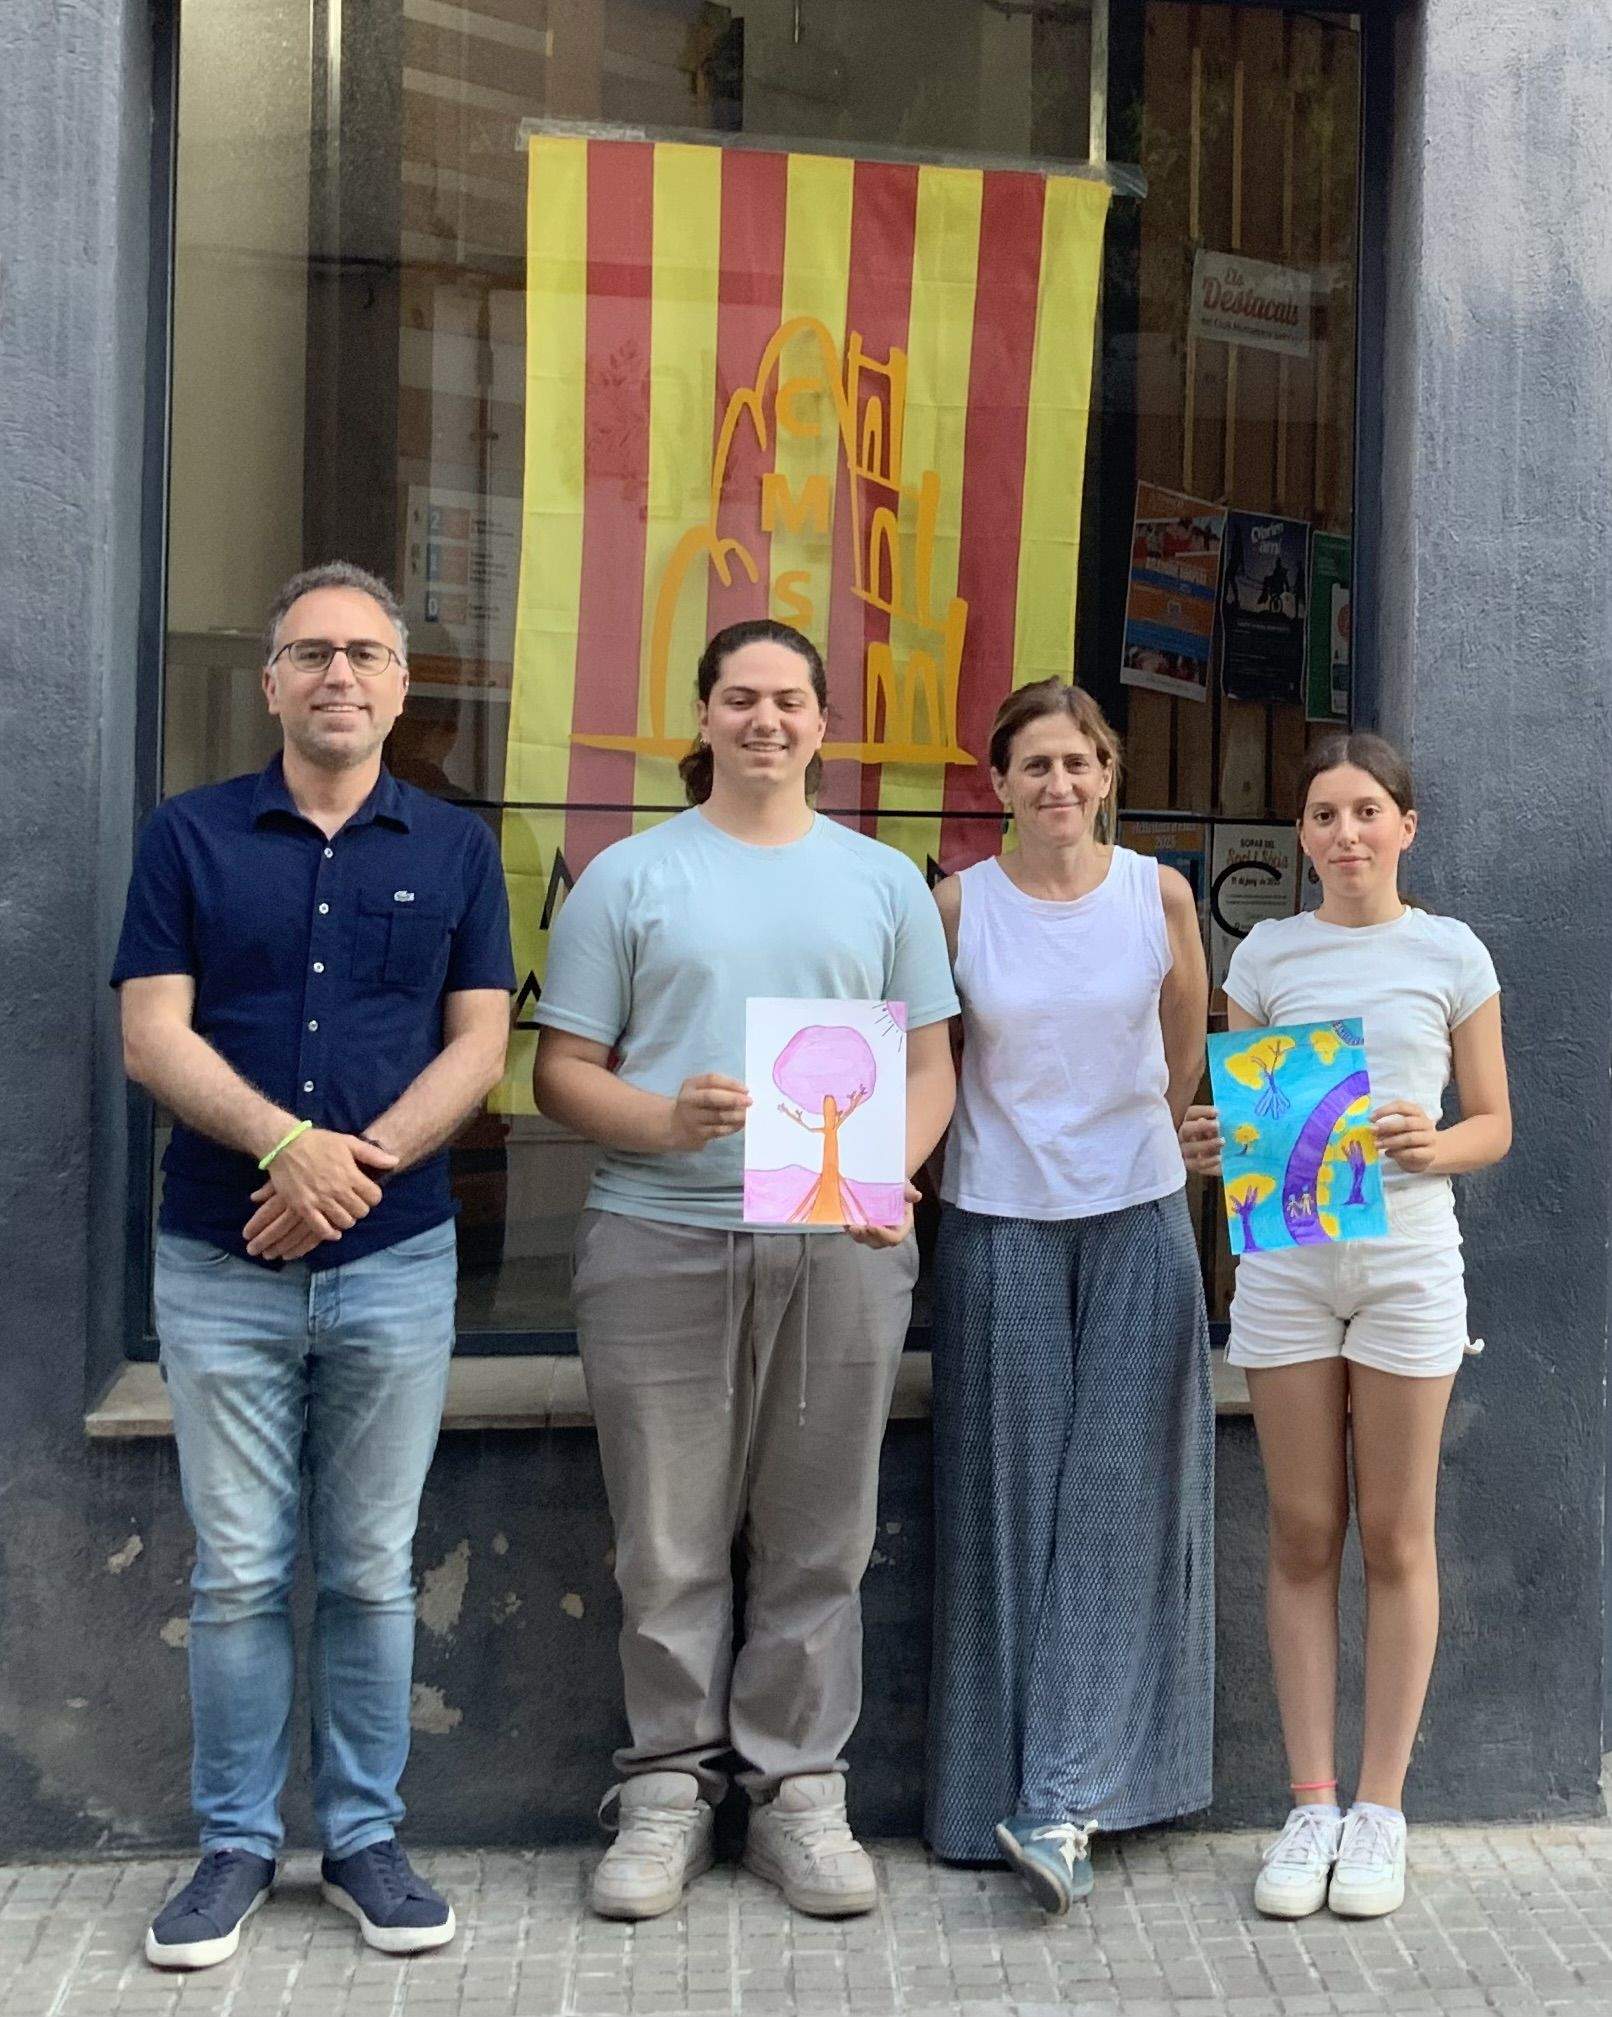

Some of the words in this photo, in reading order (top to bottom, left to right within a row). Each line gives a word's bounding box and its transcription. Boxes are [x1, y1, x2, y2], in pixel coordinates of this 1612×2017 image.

[776, 379, 823, 441] C
[761, 473, 829, 534] M
[773, 570, 814, 629] S
